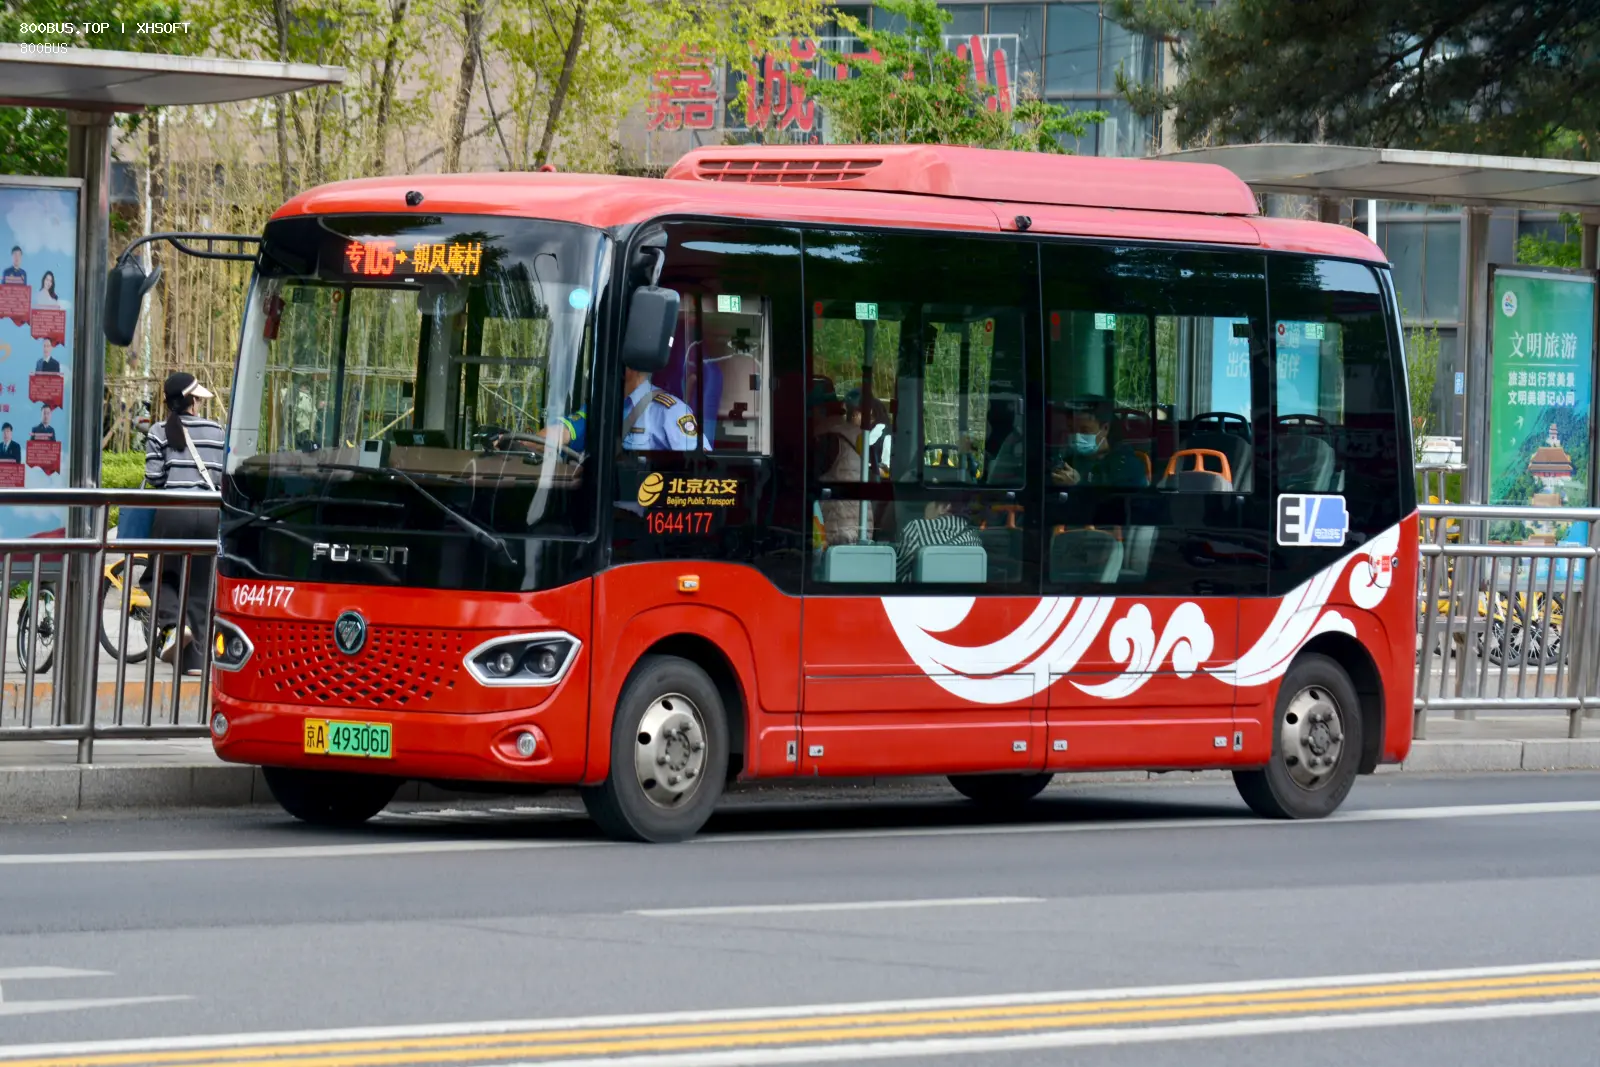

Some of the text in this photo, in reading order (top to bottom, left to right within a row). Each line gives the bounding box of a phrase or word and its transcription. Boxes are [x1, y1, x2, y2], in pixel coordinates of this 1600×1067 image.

[345, 241, 396, 275] 专105
[1508, 331, 1578, 359] 文明旅游
[1508, 372, 1575, 387] 旅游出行赏美景
[1508, 390, 1575, 406] 文明美德记心间
[668, 478, 737, 494] 北京公交
[666, 497, 735, 507] Beijing Public Transport
[646, 511, 713, 534] 1644177
[312, 542, 409, 565] FOTON
[232, 584, 294, 607] 1644177
